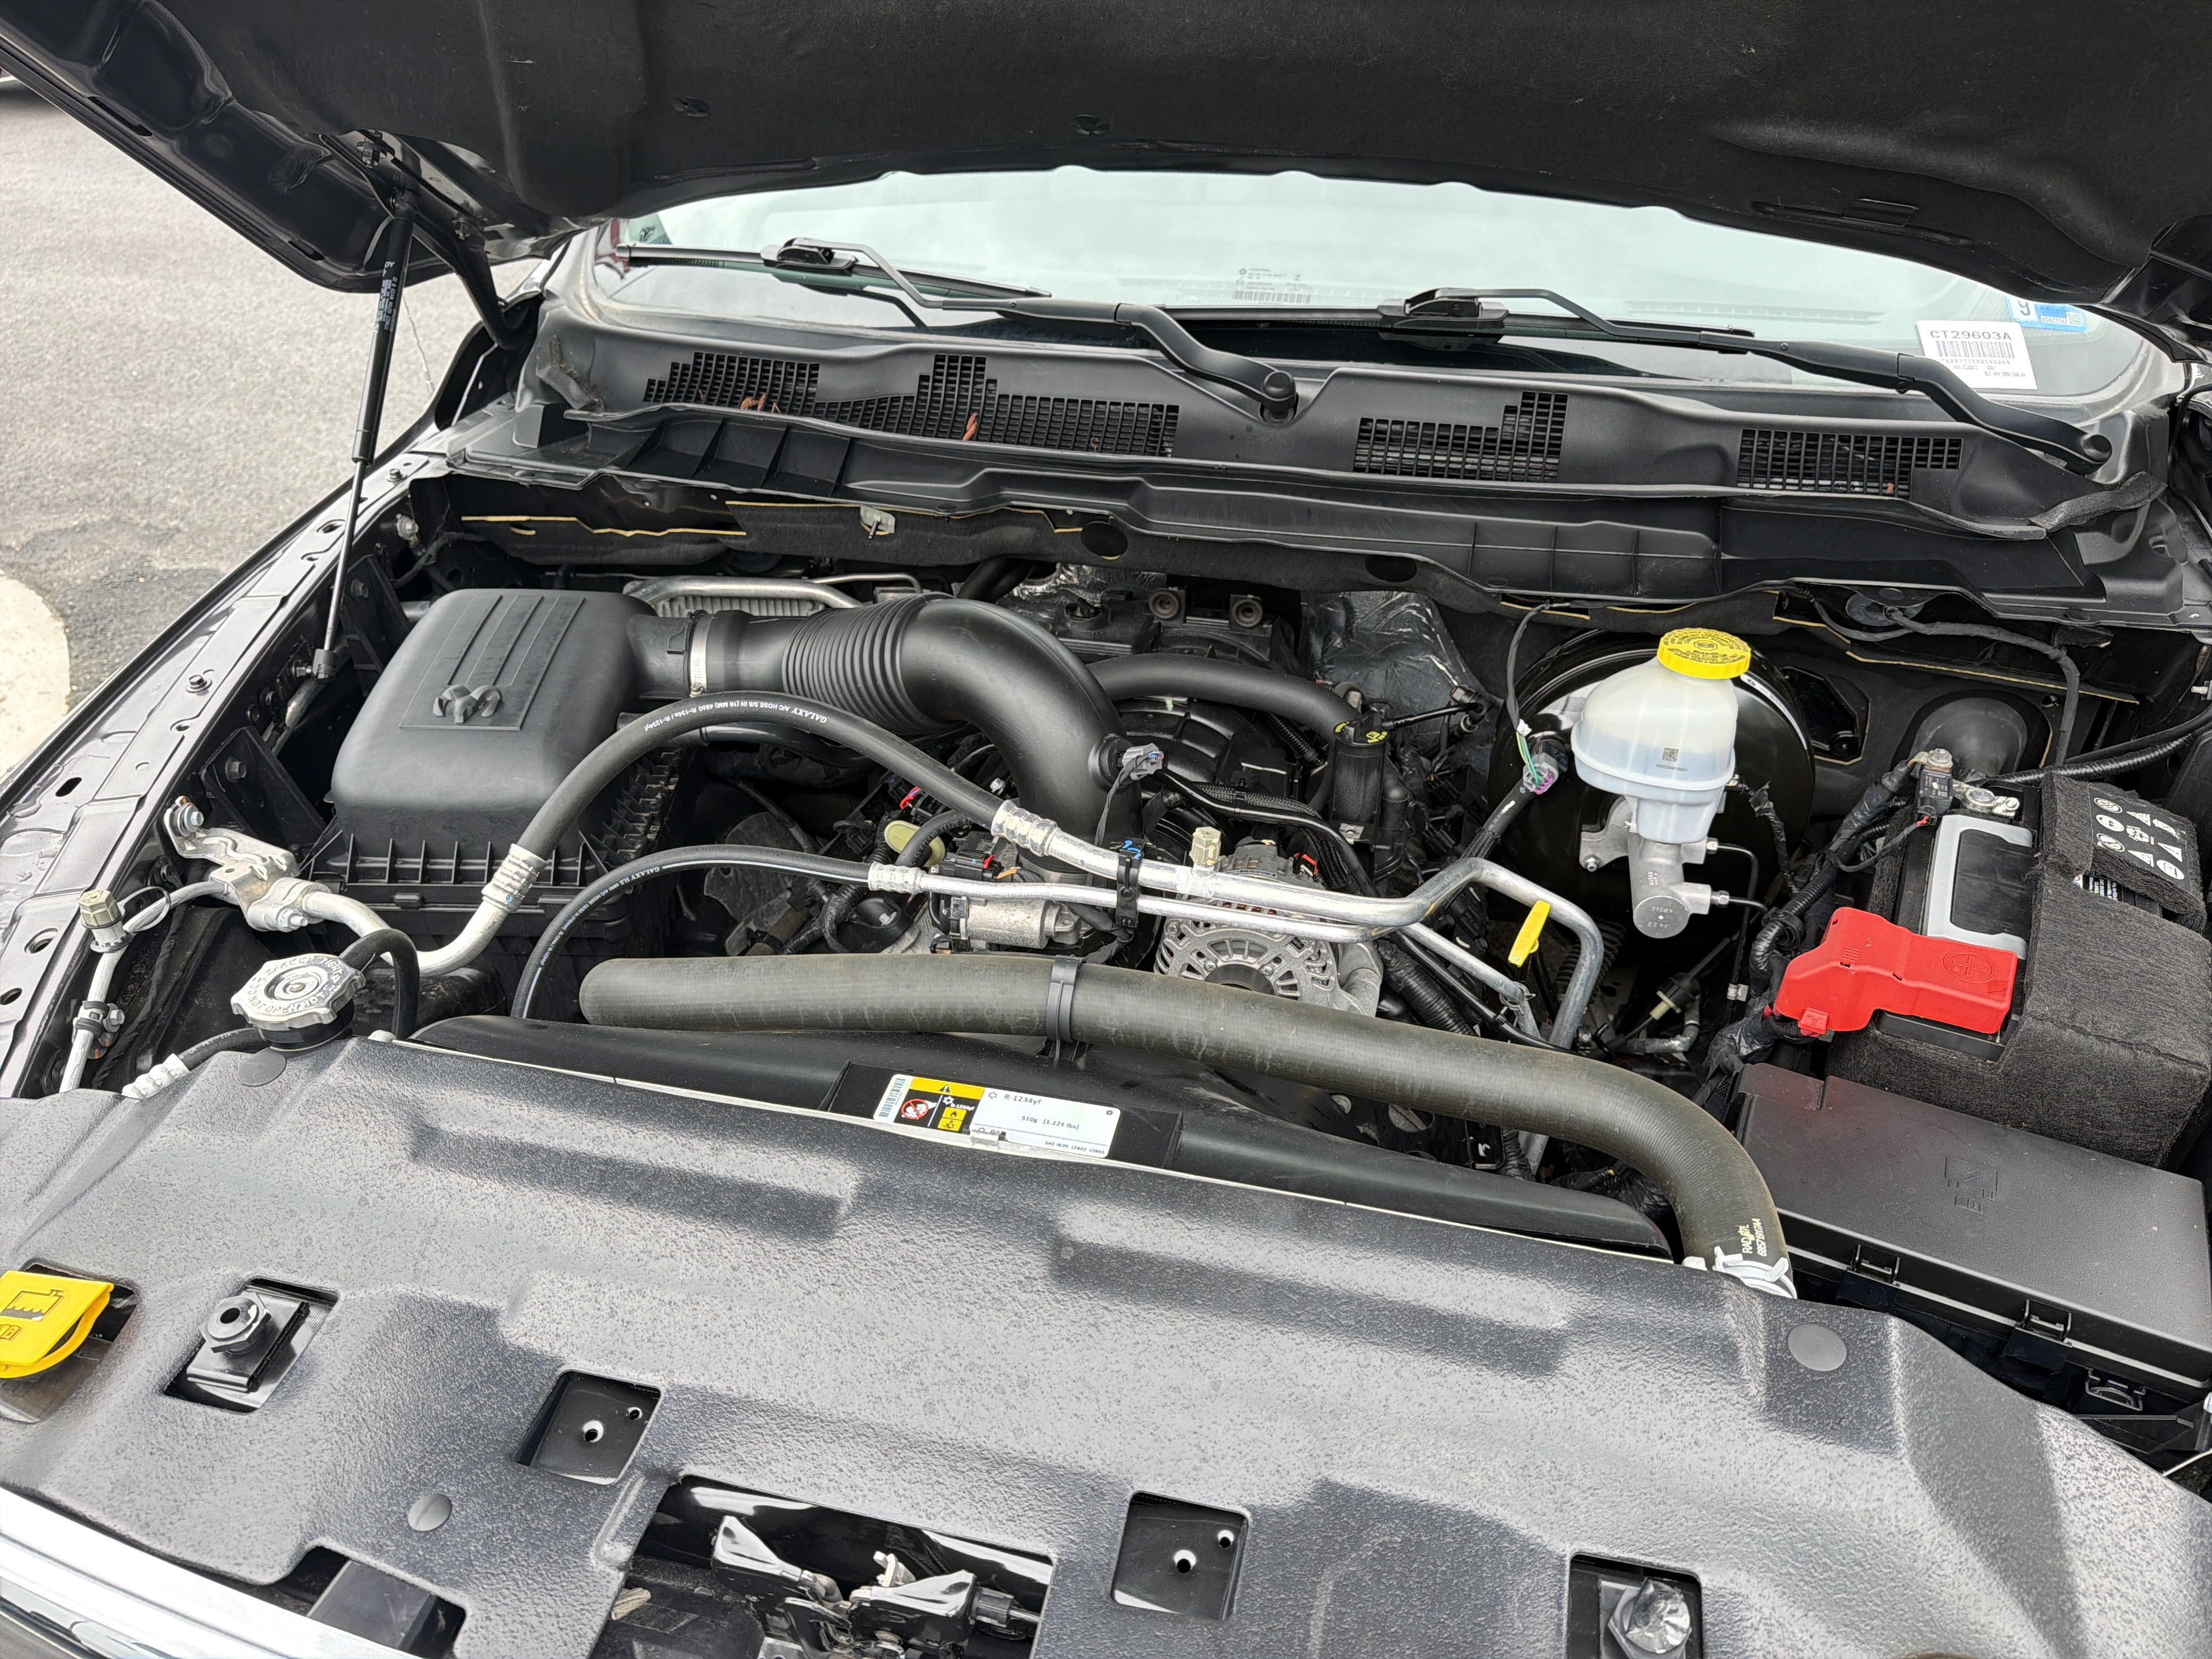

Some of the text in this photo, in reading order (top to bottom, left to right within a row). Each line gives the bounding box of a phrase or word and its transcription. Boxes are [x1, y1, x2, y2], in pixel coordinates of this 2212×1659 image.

[1930, 330, 2012, 340] CT29603A
[674, 707, 697, 718] R-134a
[698, 703, 714, 712] 4860
[791, 708, 828, 724] GALAXY
[630, 866, 660, 882] GALAXY
[588, 894, 602, 905] HOSE
[319, 957, 343, 975] TIGHT
[1004, 1093, 1042, 1105] R-1234yf
[1020, 1115, 1038, 1124] 510g
[1042, 1118, 1065, 1127] (1.125
